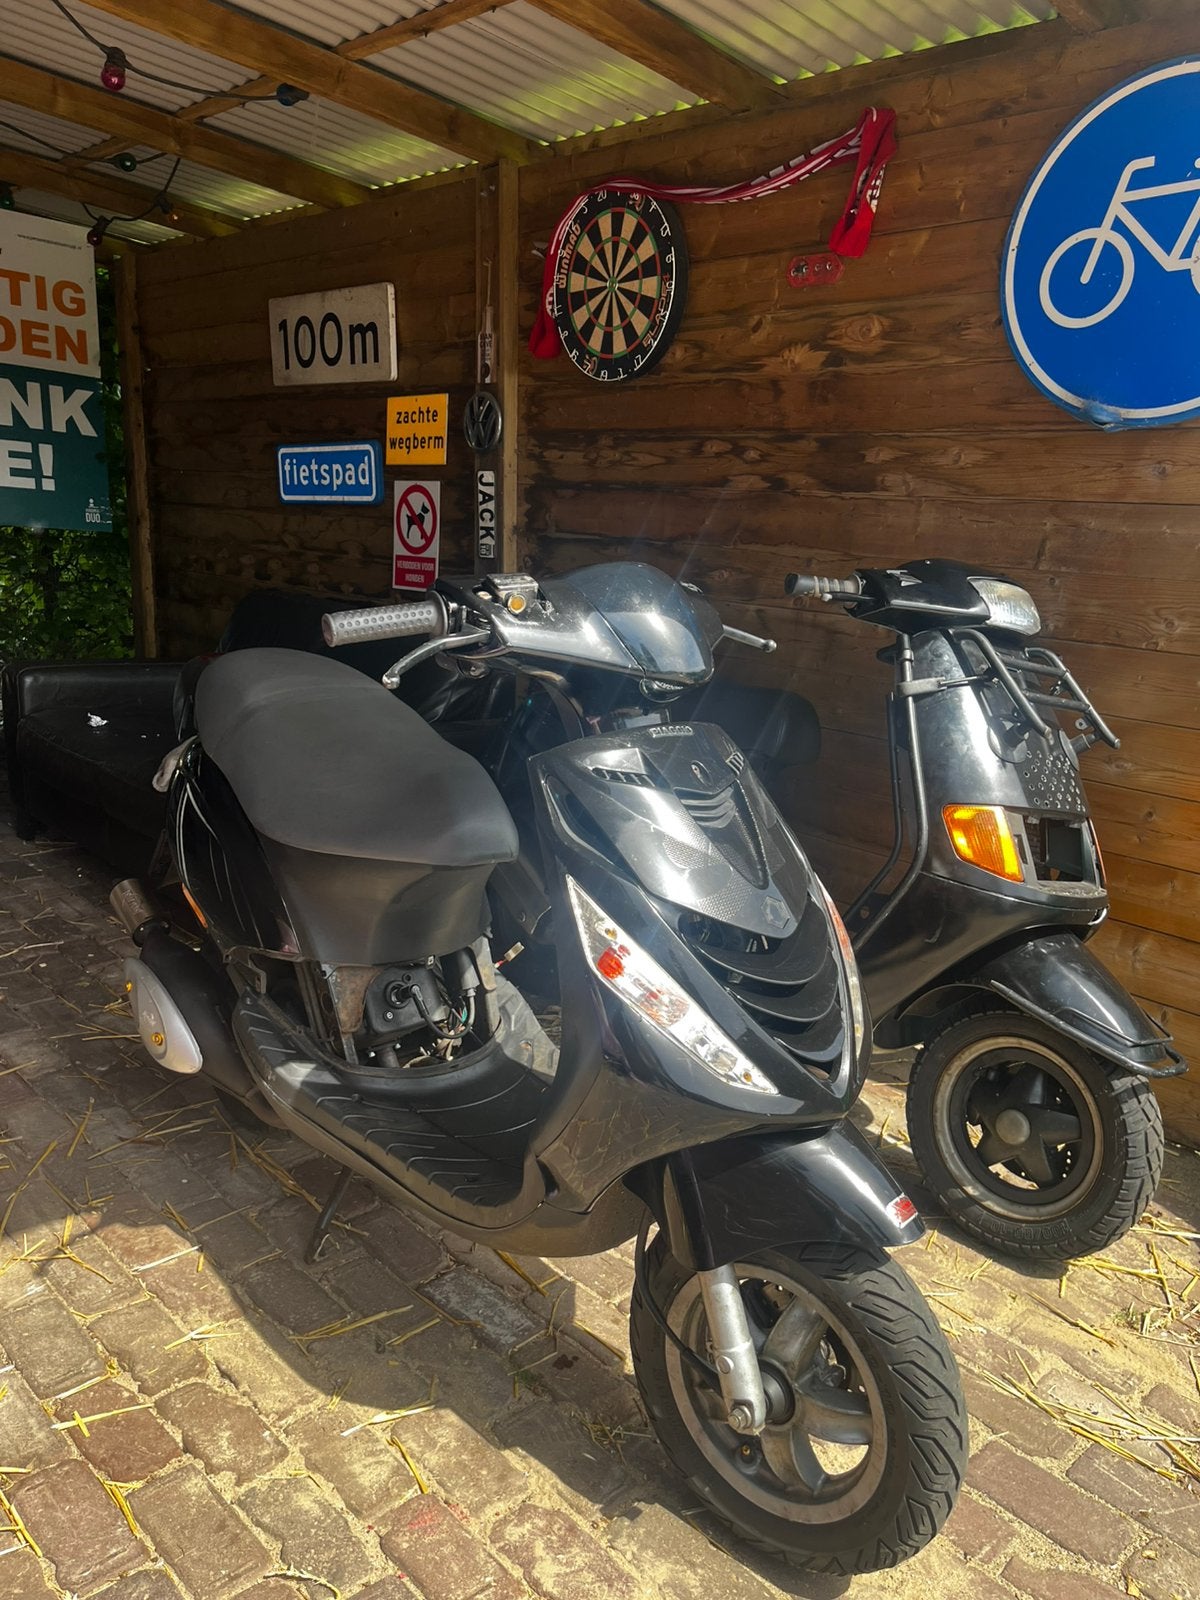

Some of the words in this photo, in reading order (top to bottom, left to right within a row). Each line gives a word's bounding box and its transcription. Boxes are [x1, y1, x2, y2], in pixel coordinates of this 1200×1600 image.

[0, 268, 87, 318] TIG
[0, 377, 98, 438] NK
[396, 406, 439, 425] zachte
[389, 432, 444, 454] wegberm
[0, 439, 56, 491] E!
[284, 455, 370, 491] fietspad
[478, 473, 495, 541] JACK
[421, 562, 435, 571] VOOR
[648, 725, 694, 738] PIAGGIO
